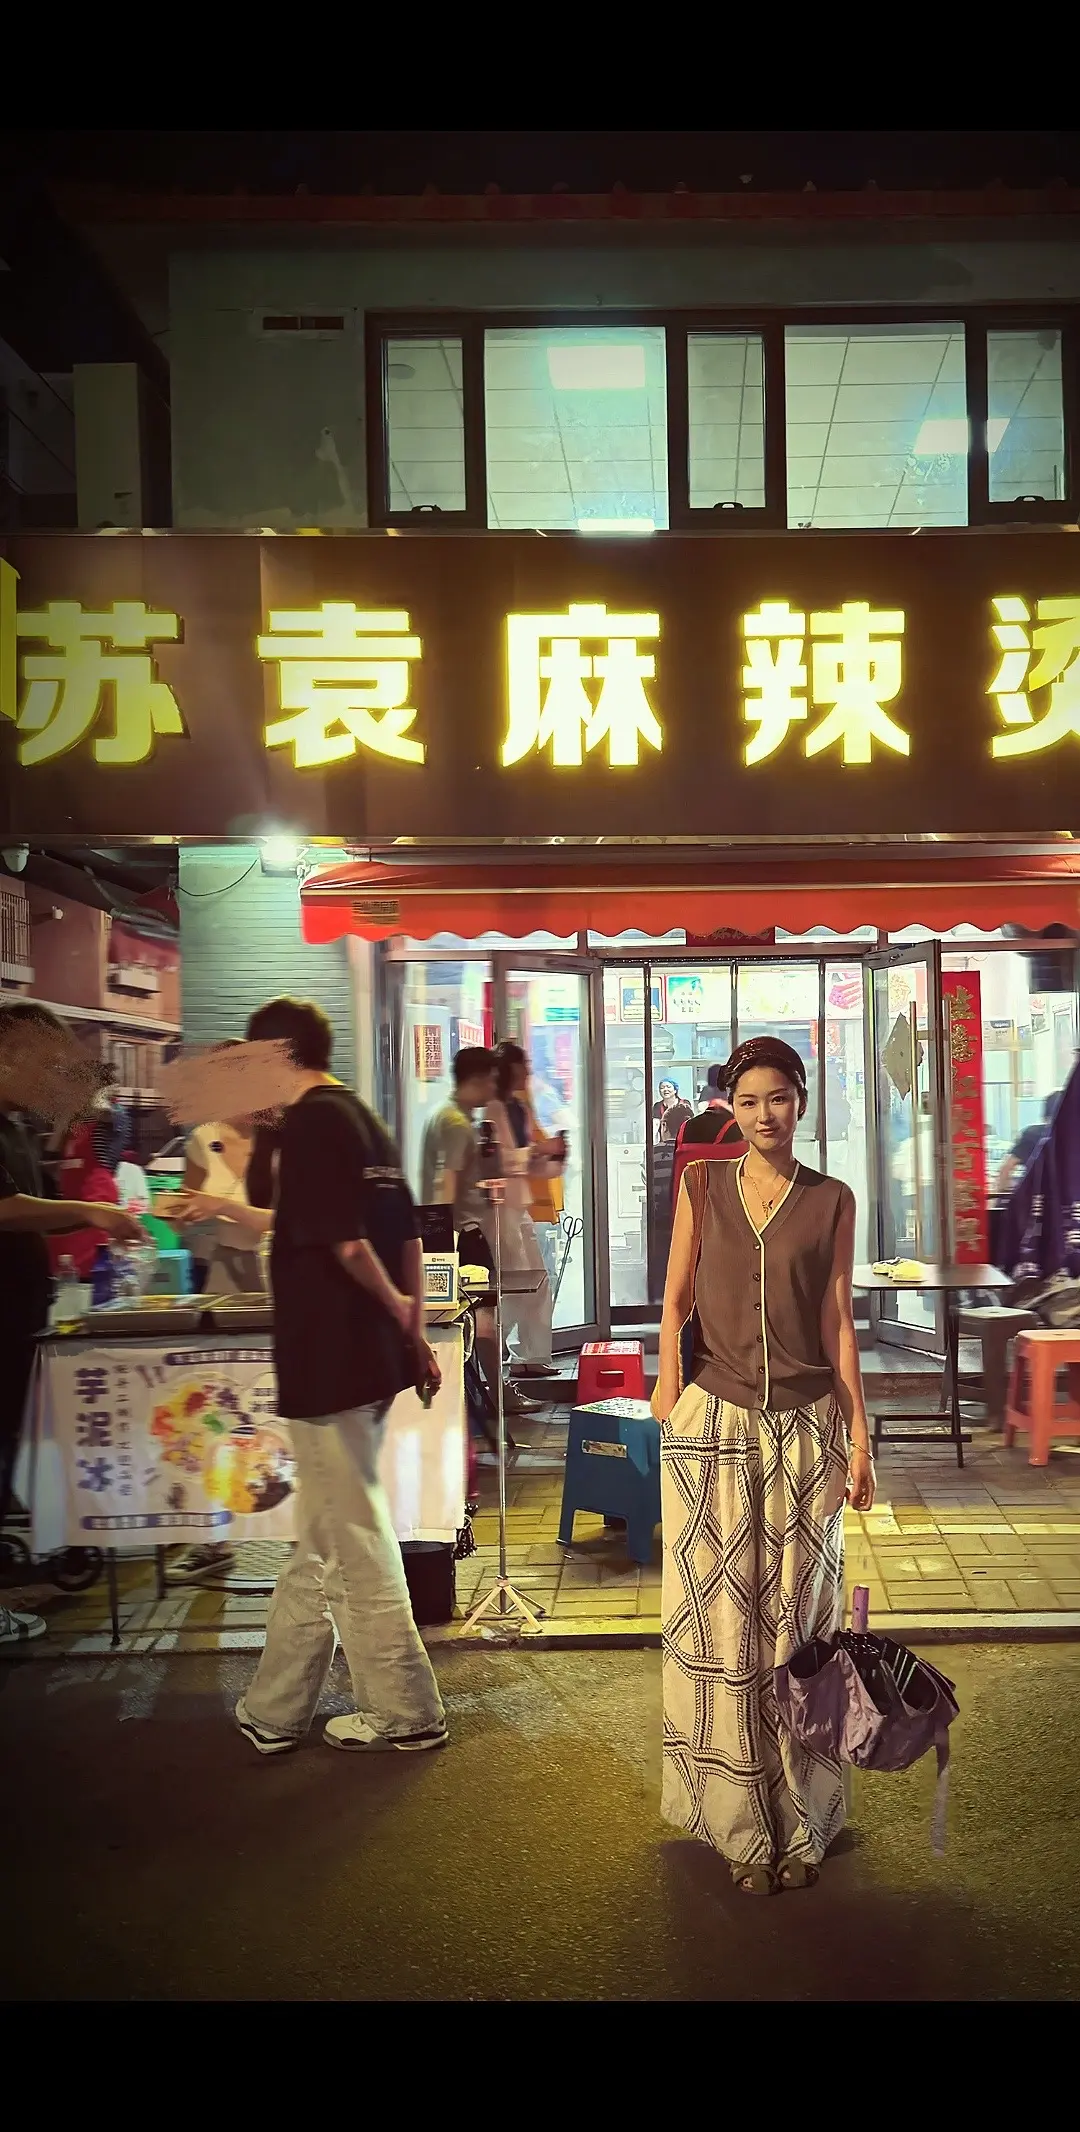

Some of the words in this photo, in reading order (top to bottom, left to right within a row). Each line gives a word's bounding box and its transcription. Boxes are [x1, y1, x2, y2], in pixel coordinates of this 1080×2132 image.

[16, 597, 1080, 768] 苏袁麻辣烫
[74, 1367, 113, 1492] 芋泥冰
